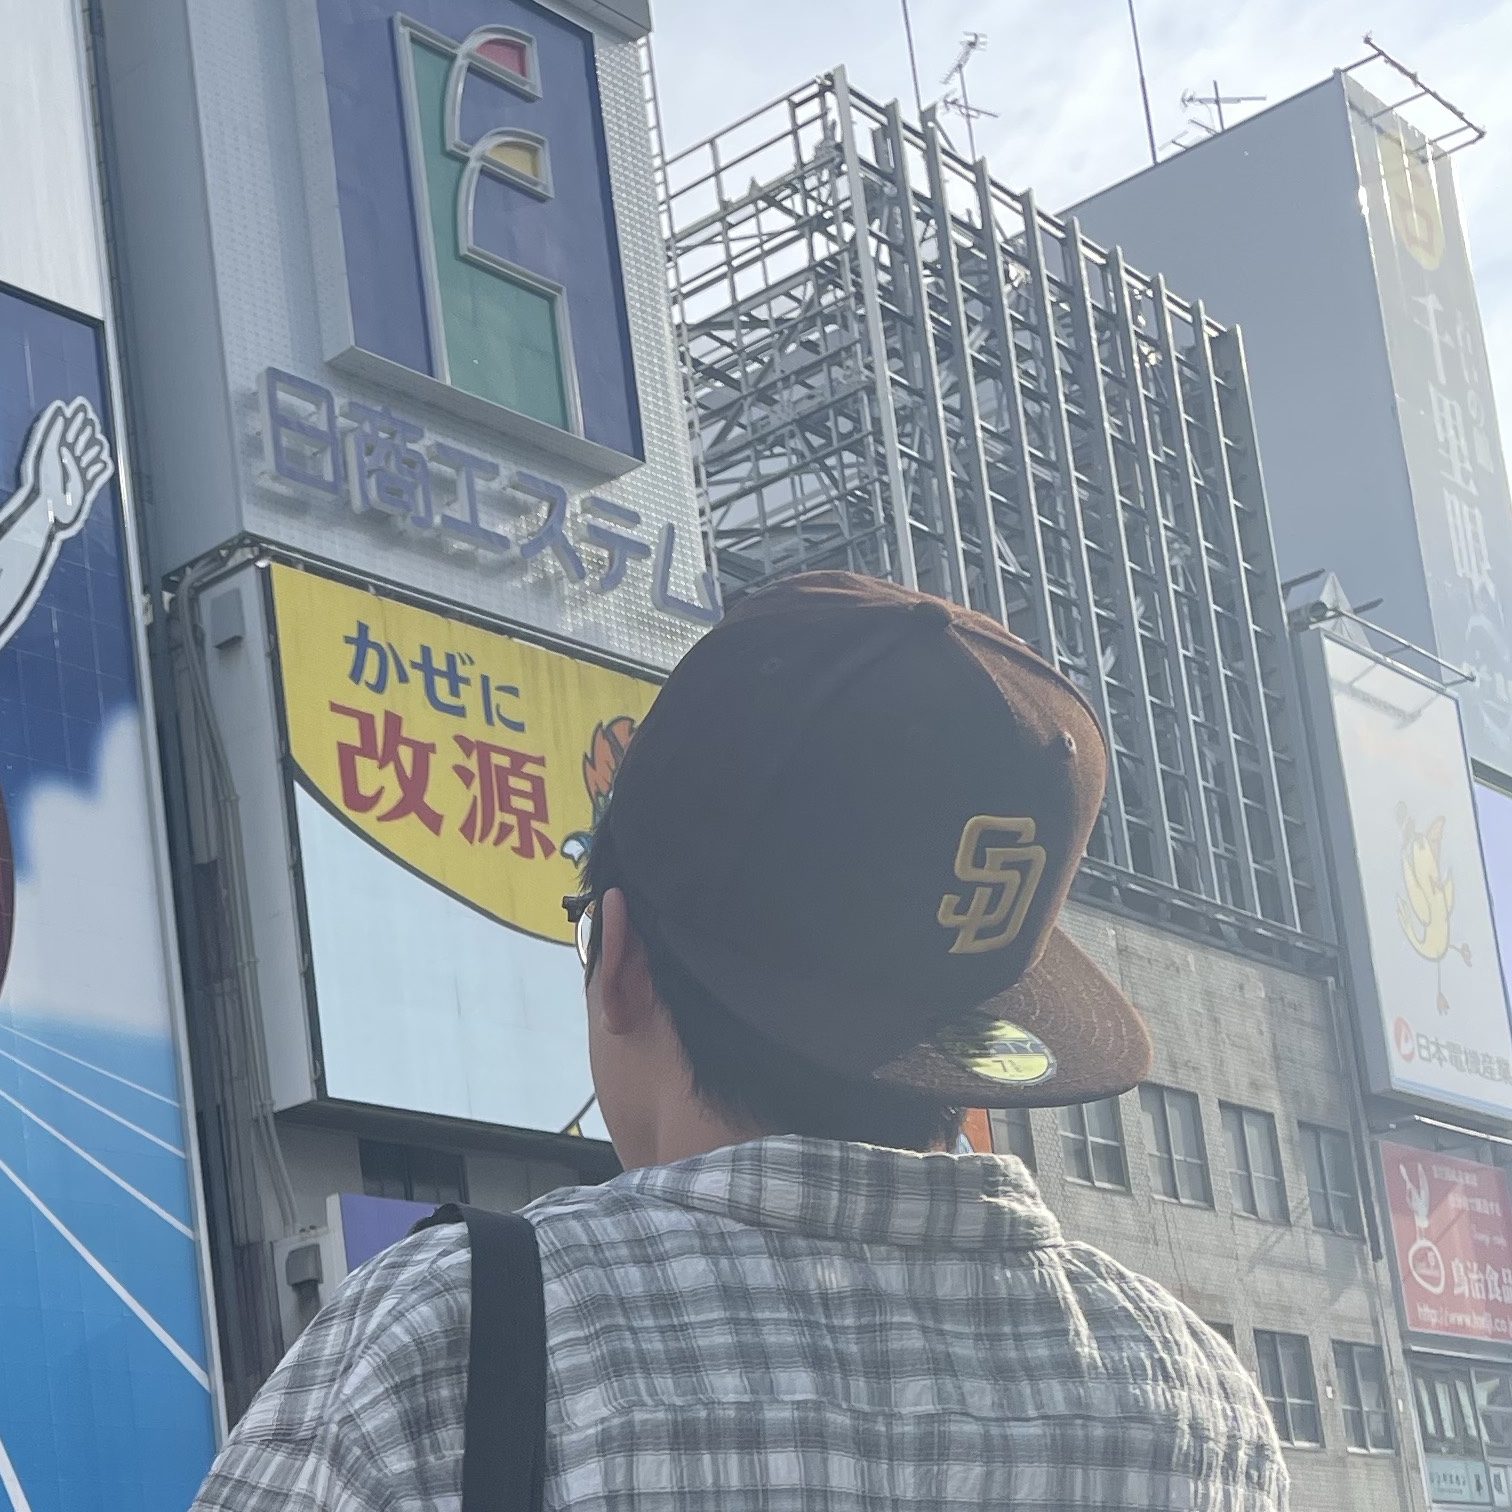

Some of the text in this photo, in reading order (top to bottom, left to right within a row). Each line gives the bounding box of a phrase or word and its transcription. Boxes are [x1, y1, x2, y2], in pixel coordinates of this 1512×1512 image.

[343, 619, 526, 734] かぜに
[328, 699, 557, 861] 改源
[937, 814, 1047, 954] SD
